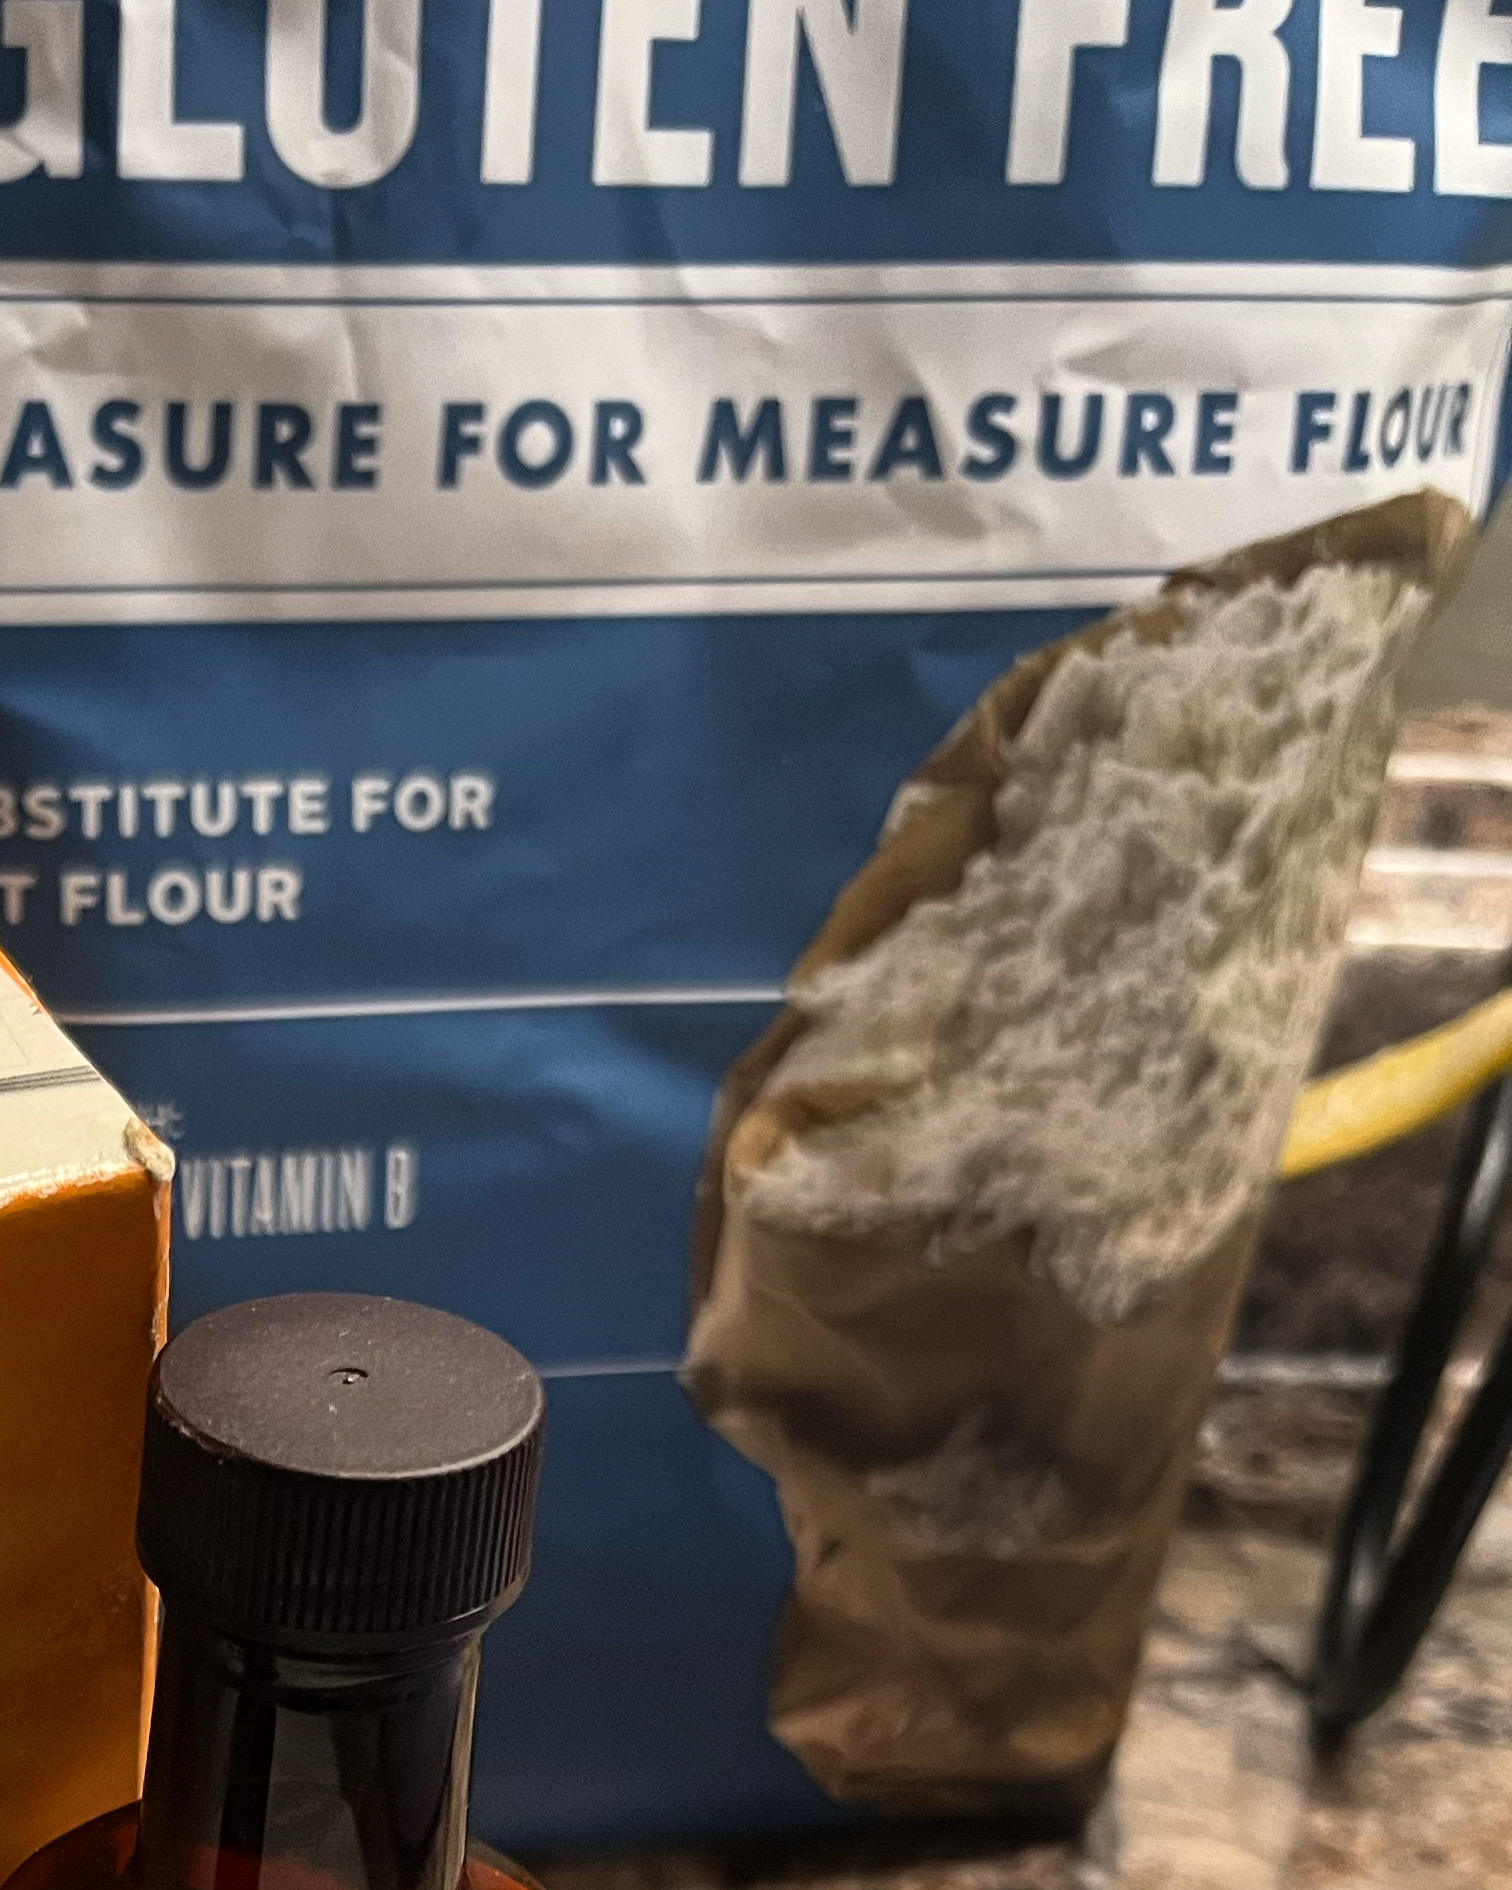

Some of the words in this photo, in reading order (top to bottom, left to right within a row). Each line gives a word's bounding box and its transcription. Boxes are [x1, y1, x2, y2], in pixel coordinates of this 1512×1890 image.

[434, 395, 650, 488] FOR
[694, 388, 1237, 485] MEASURE
[1290, 382, 1471, 474] FLOUR
[350, 775, 494, 831] FOR
[61, 869, 302, 925] FLOUR
[181, 1149, 372, 1240] VITAMIN
